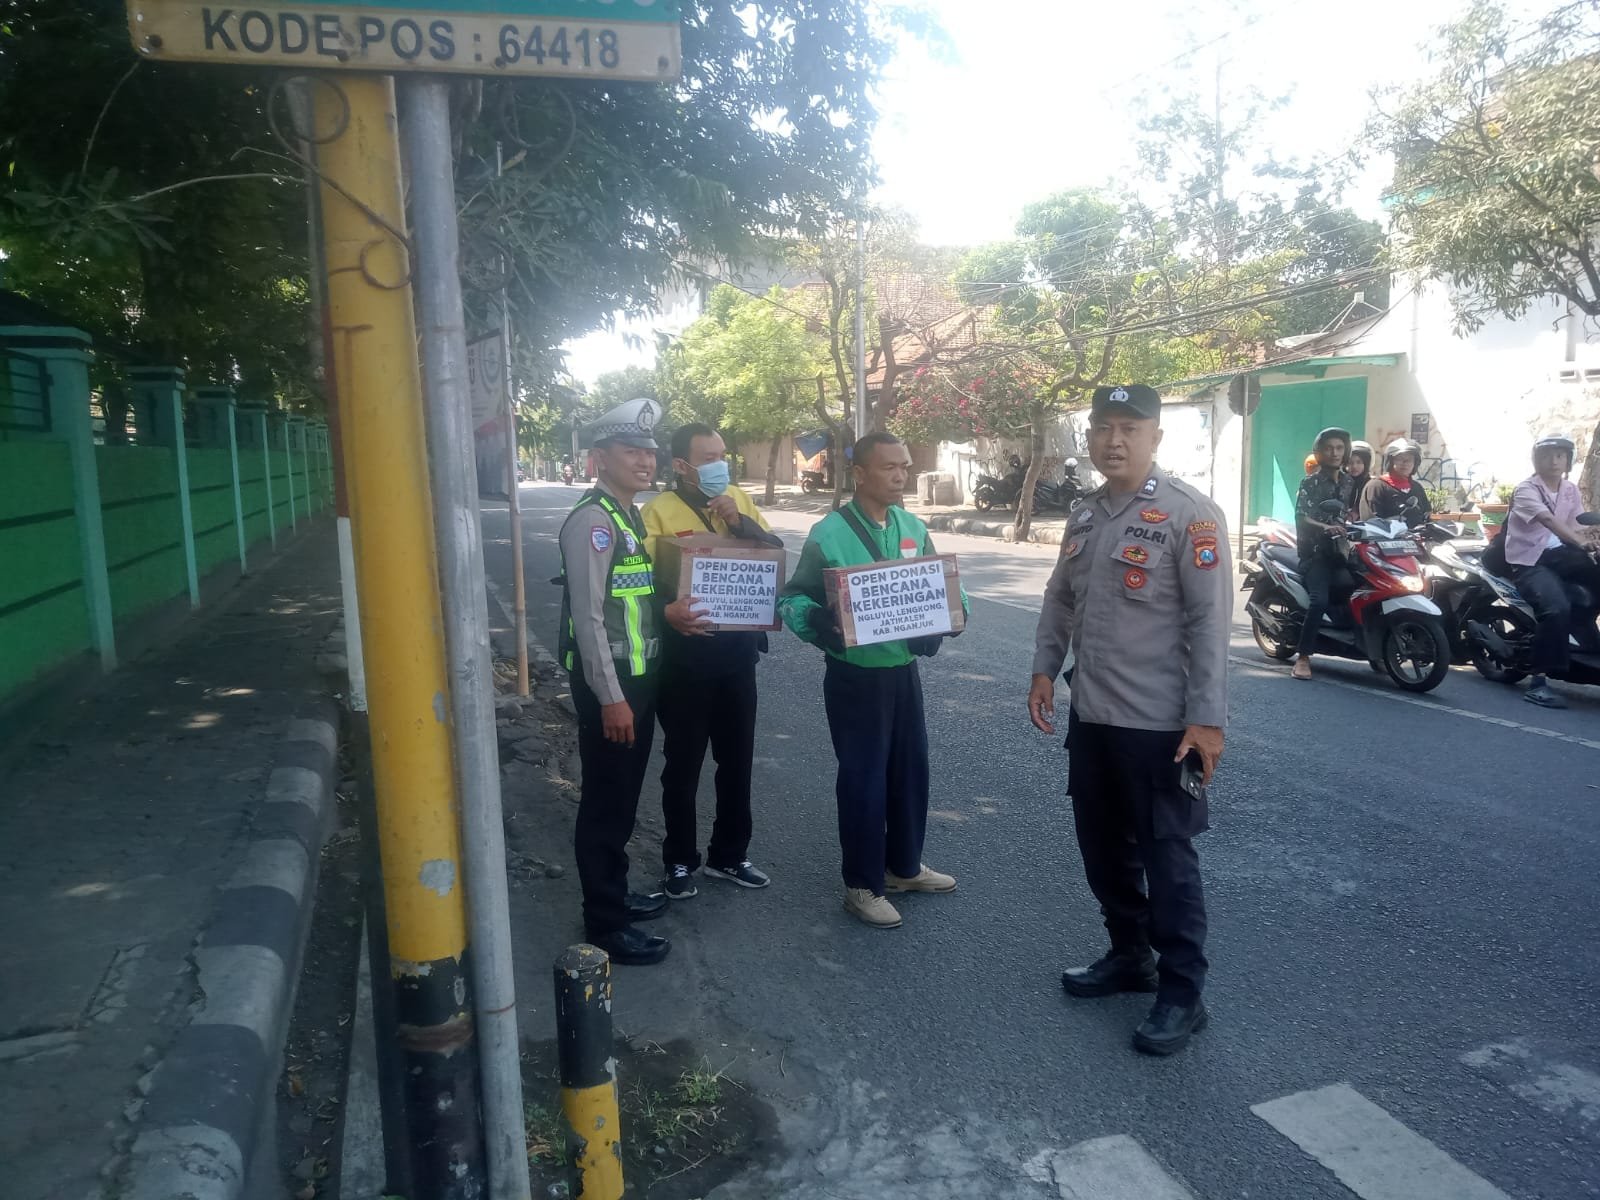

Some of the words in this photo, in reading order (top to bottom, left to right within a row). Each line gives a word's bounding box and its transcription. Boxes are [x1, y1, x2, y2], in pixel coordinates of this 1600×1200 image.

[202, 8, 342, 55] KODE
[358, 16, 456, 61] POS
[499, 24, 620, 68] 64418
[1125, 526, 1167, 544] POLRI
[695, 561, 728, 571] OPEN
[731, 562, 775, 573] DONASI
[702, 572, 764, 584] BENCANA
[851, 572, 887, 586] OPEN
[890, 564, 940, 580] DONASI
[692, 583, 775, 596] KEKERINGAN
[861, 578, 931, 598] BENCANA
[852, 588, 945, 612] KEKERINGAN
[858, 610, 895, 622] NGLUYU,
[879, 613, 926, 627] JATIKALEN
[893, 620, 935, 633] NGANJUK
